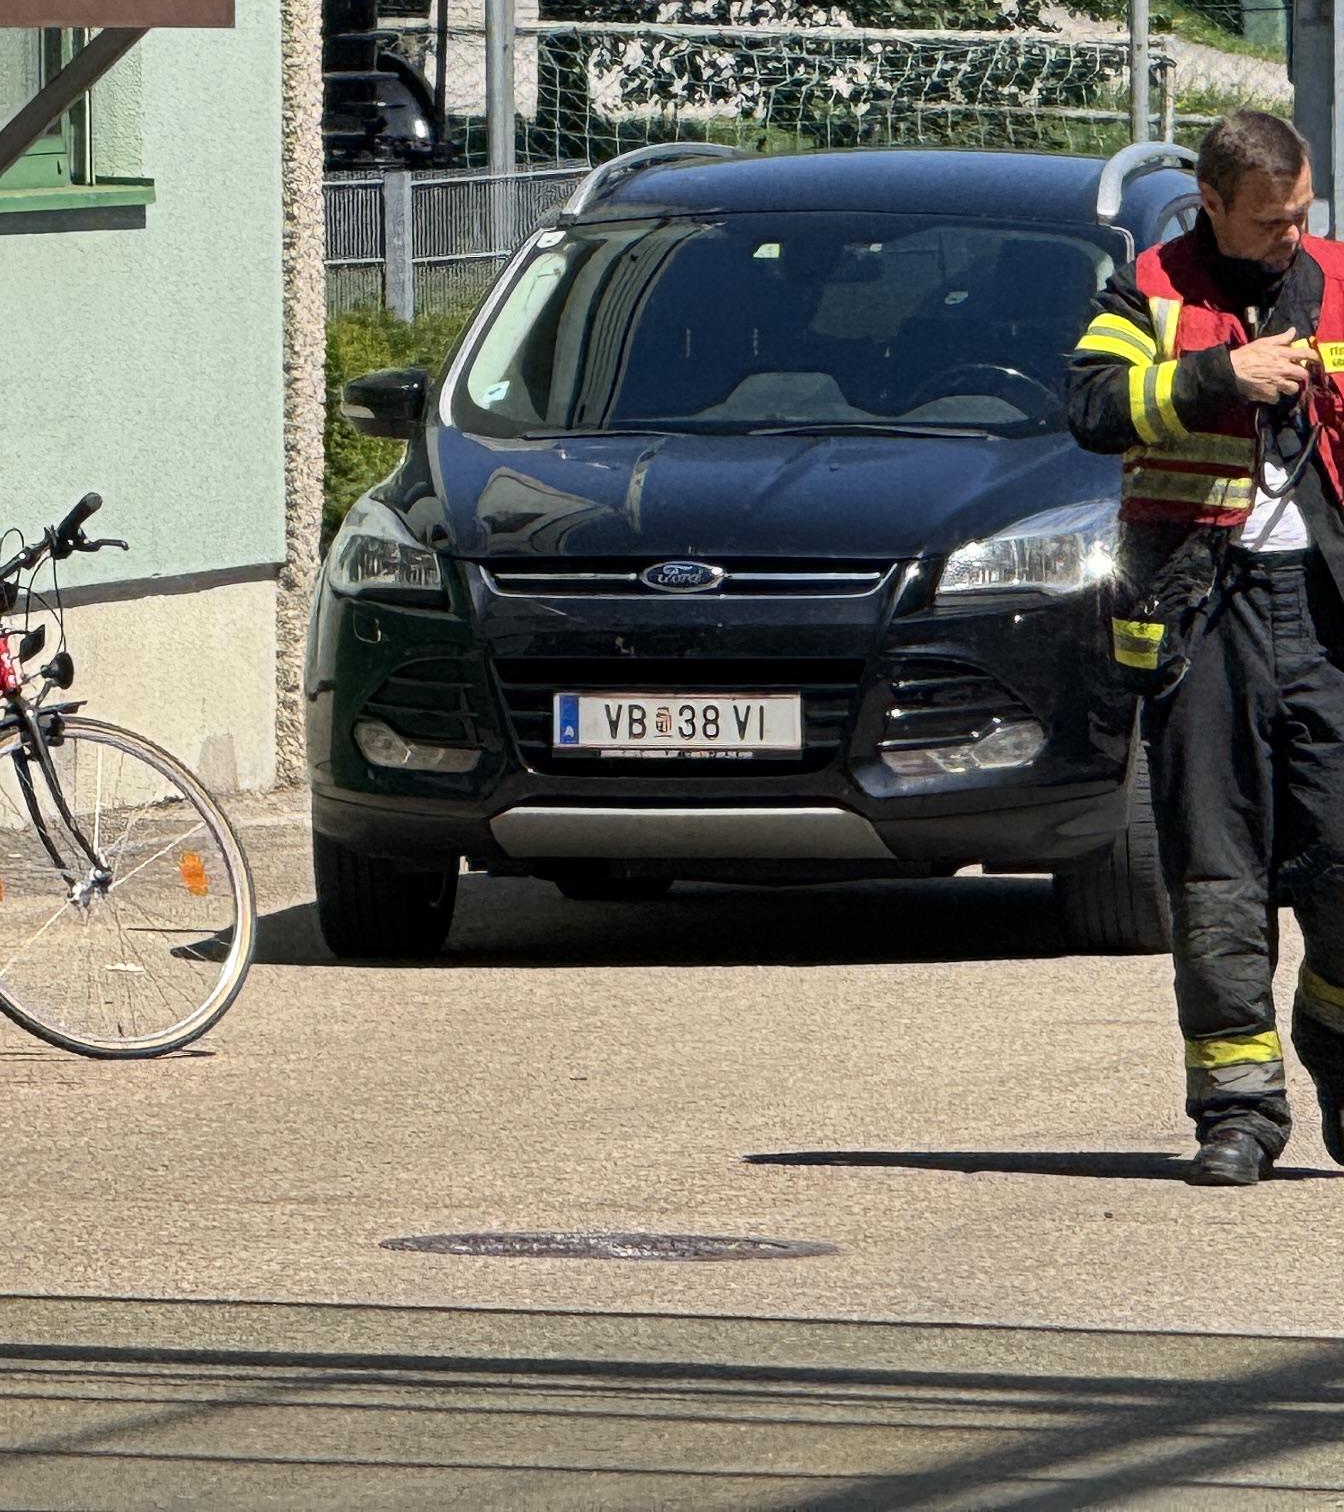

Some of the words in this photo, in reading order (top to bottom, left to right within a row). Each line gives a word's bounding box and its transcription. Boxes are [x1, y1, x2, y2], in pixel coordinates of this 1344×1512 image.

[657, 564, 702, 584] Ford
[604, 704, 648, 739] VB
[678, 704, 720, 740] 38
[732, 704, 765, 741] VI
